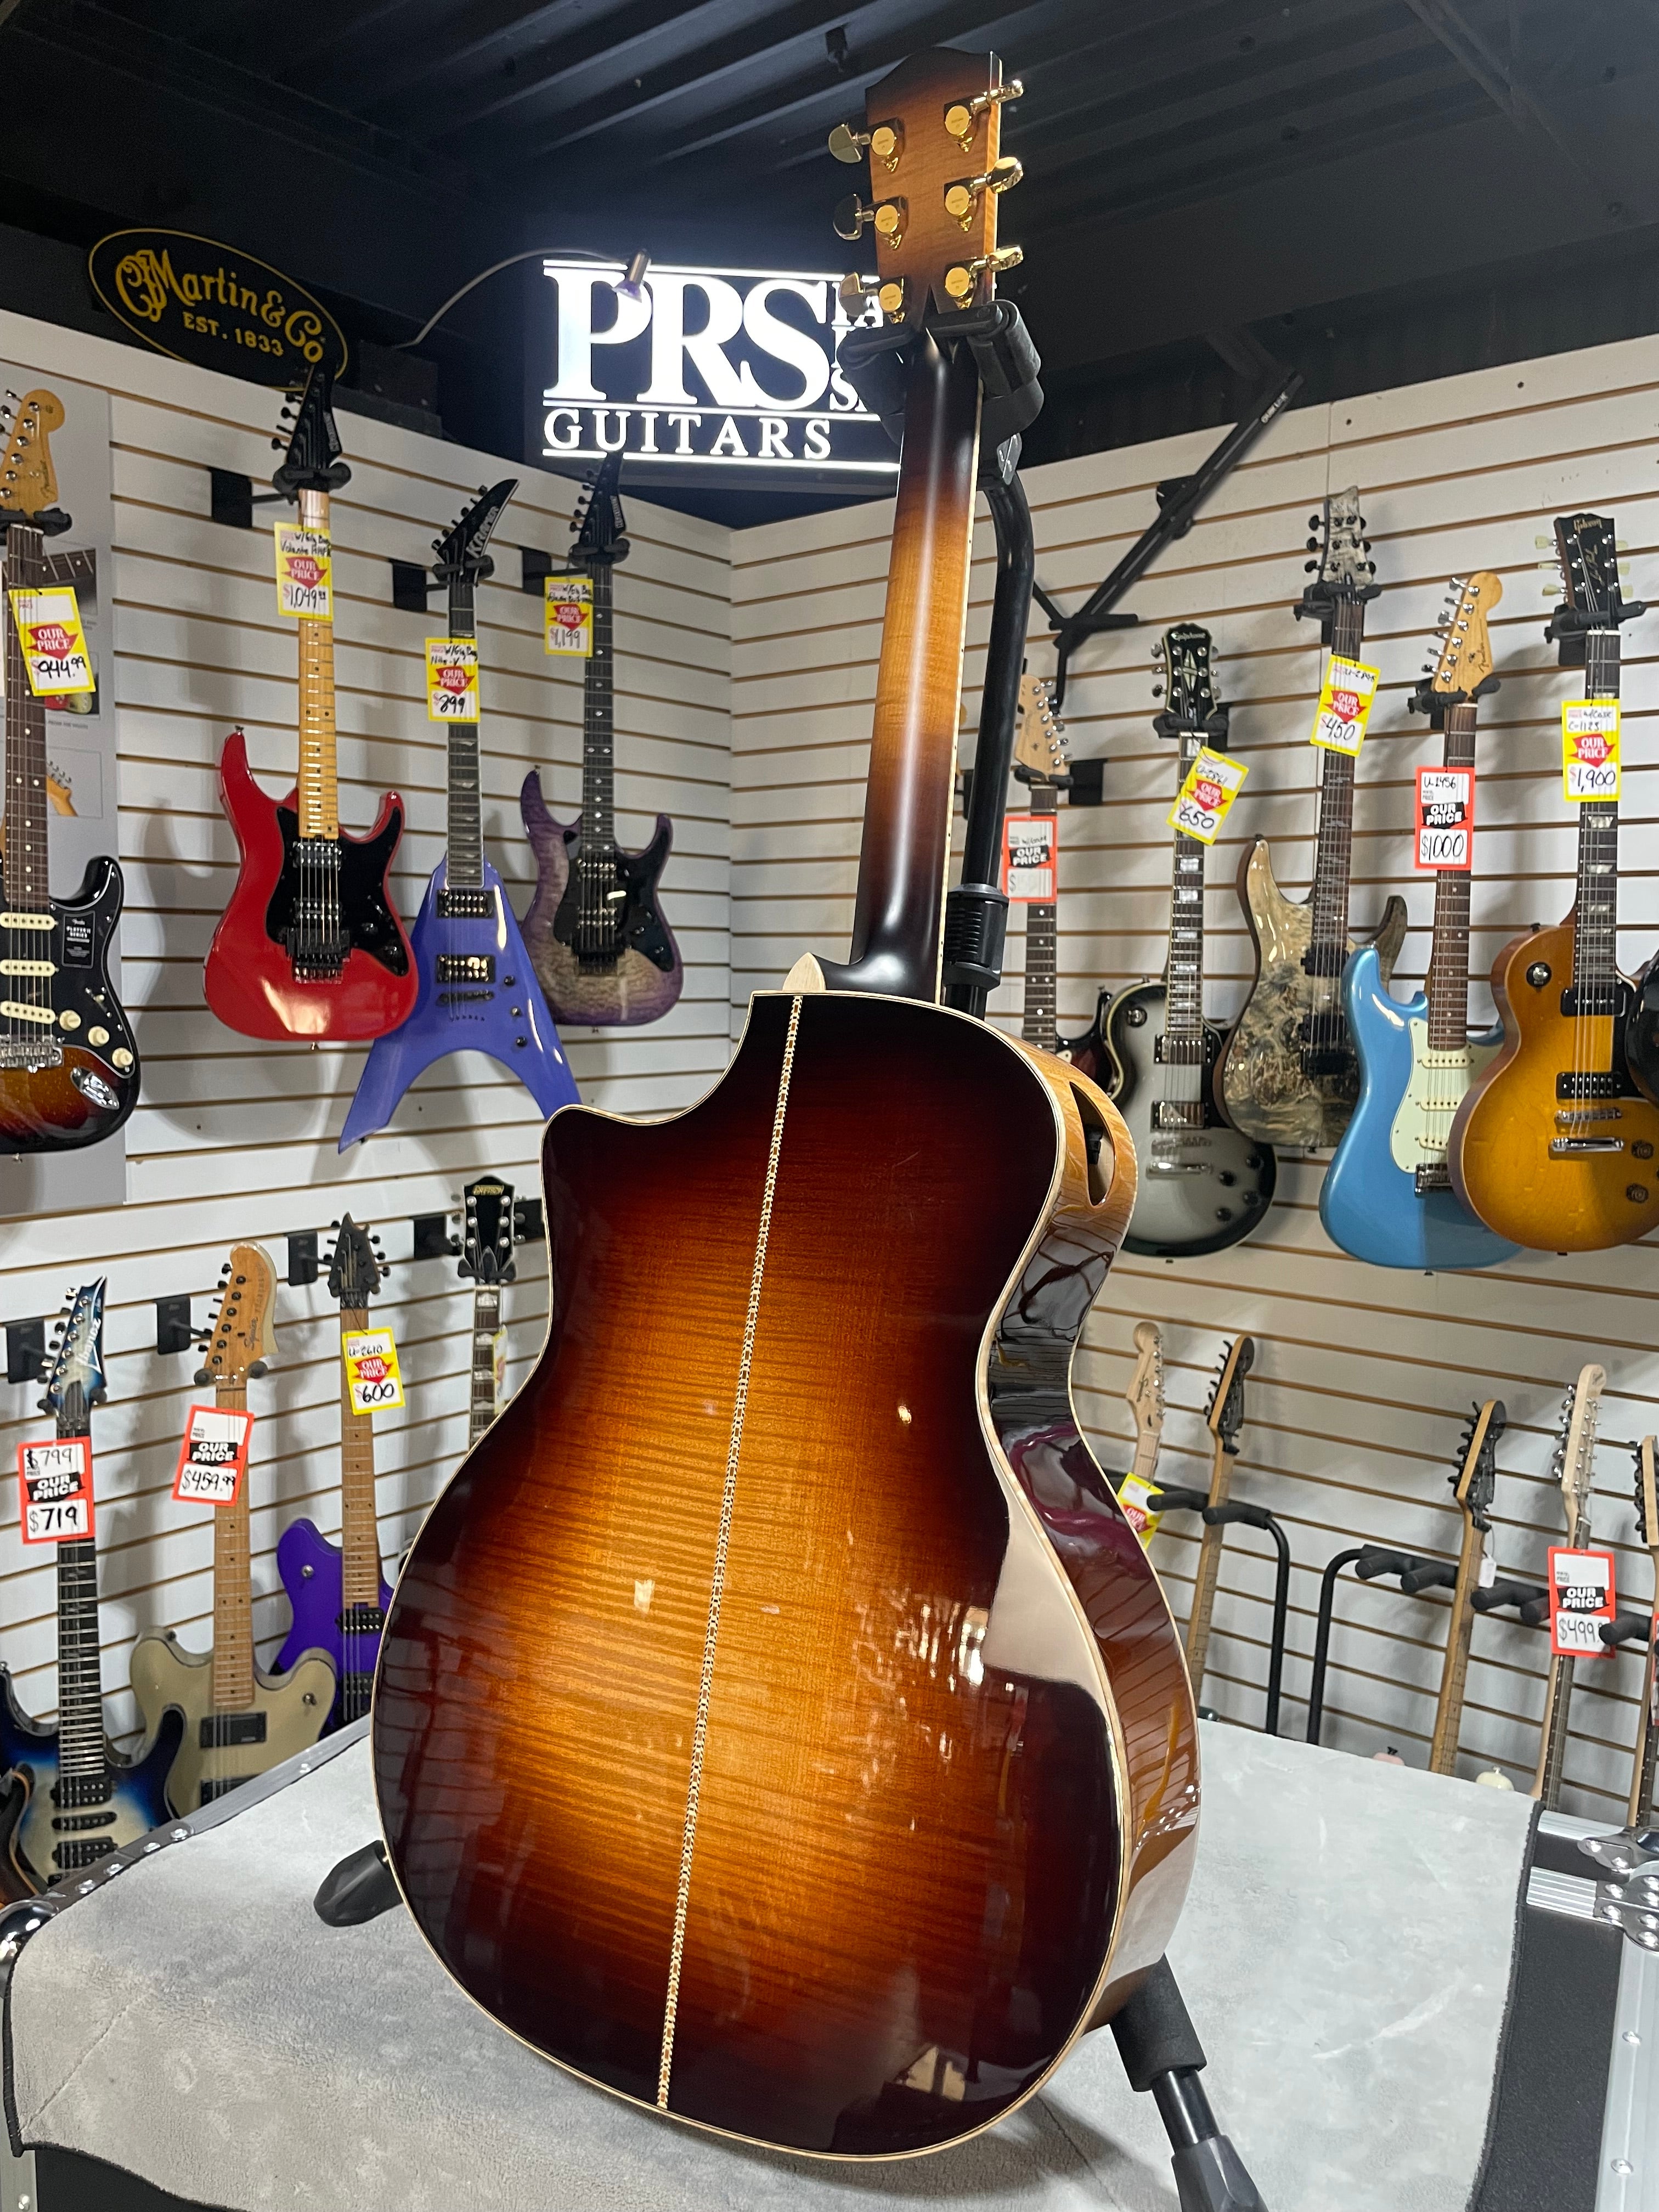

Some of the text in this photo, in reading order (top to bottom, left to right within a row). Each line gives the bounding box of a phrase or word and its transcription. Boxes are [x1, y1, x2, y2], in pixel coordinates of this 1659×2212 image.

[183, 312, 284, 357] EST. 1833
[543, 268, 830, 410] PRS
[544, 408, 832, 460] GUITARS
[294, 559, 317, 572] OUR
[291, 570, 320, 581] PRICE
[38, 628, 65, 640] OUR
[36, 638, 70, 651] PRICE
[442, 669, 465, 679] OUR
[1337, 692, 1358, 706] OUR
[1333, 702, 1360, 716] PRICE
[1581, 737, 1605, 748] OUR
[1578, 747, 1607, 759] PRICE
[1200, 782, 1221, 798] OUR
[1430, 803, 1457, 816] OUR
[1426, 811, 1462, 826] PRICE
[1016, 847, 1042, 857] OUR
[1421, 834, 1464, 861] $1000
[1012, 853, 1048, 866] PRICE
[362, 1358, 383, 1369] OUR
[359, 1365, 388, 1379] PRICE
[198, 1442, 229, 1453] OUR
[191, 1451, 235, 1462] PRICE
[37, 1474, 71, 1490] OUR
[32, 1481, 79, 1502] PRICE
[29, 1505, 77, 1532] $719
[1566, 1588, 1596, 1598] OUR
[1562, 1596, 1604, 1608] PRICE
